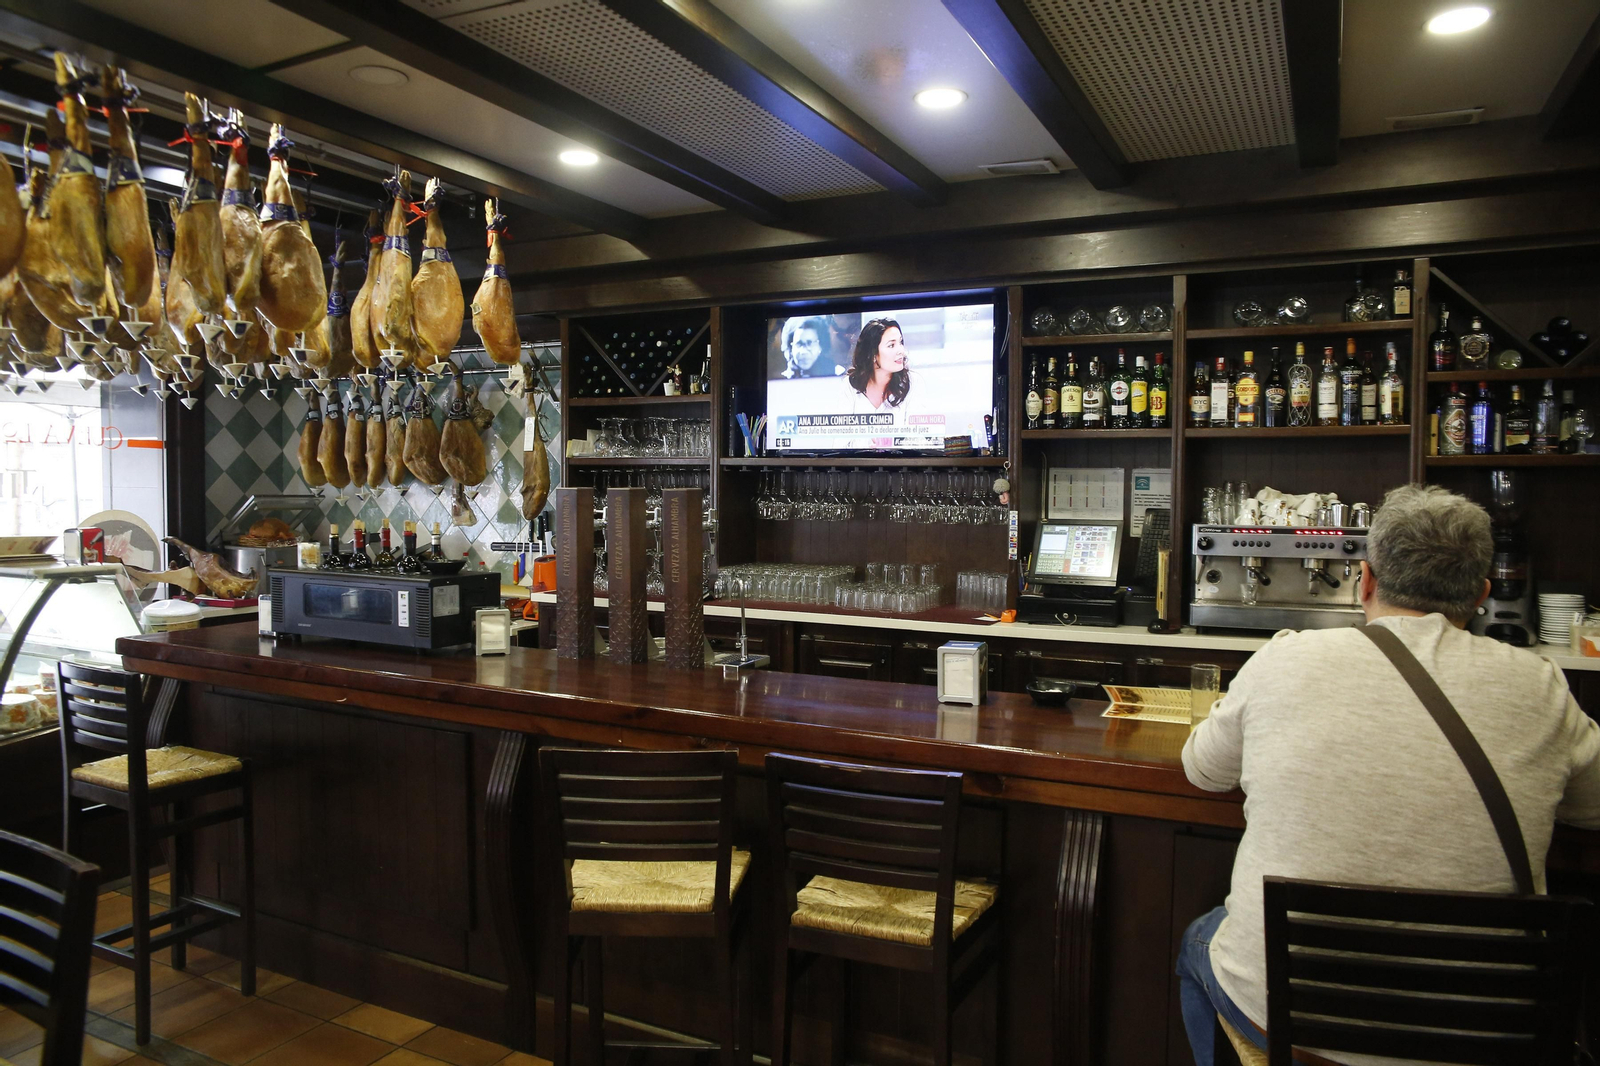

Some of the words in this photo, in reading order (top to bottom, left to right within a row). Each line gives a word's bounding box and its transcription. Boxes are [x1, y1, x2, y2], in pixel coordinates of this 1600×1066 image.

[779, 420, 796, 435] AR
[798, 416, 811, 426] ANA
[812, 416, 829, 425] JULIA
[830, 415, 860, 425] CONFIESA
[860, 415, 868, 424] EL
[868, 414, 893, 424] CRIMEN
[929, 415, 945, 424] HORA
[615, 496, 623, 538] ALHAMBRA
[670, 496, 679, 540] ALHAMBRA
[615, 540, 623, 580] CERVEZAS
[671, 543, 680, 583] CERVEZAS
